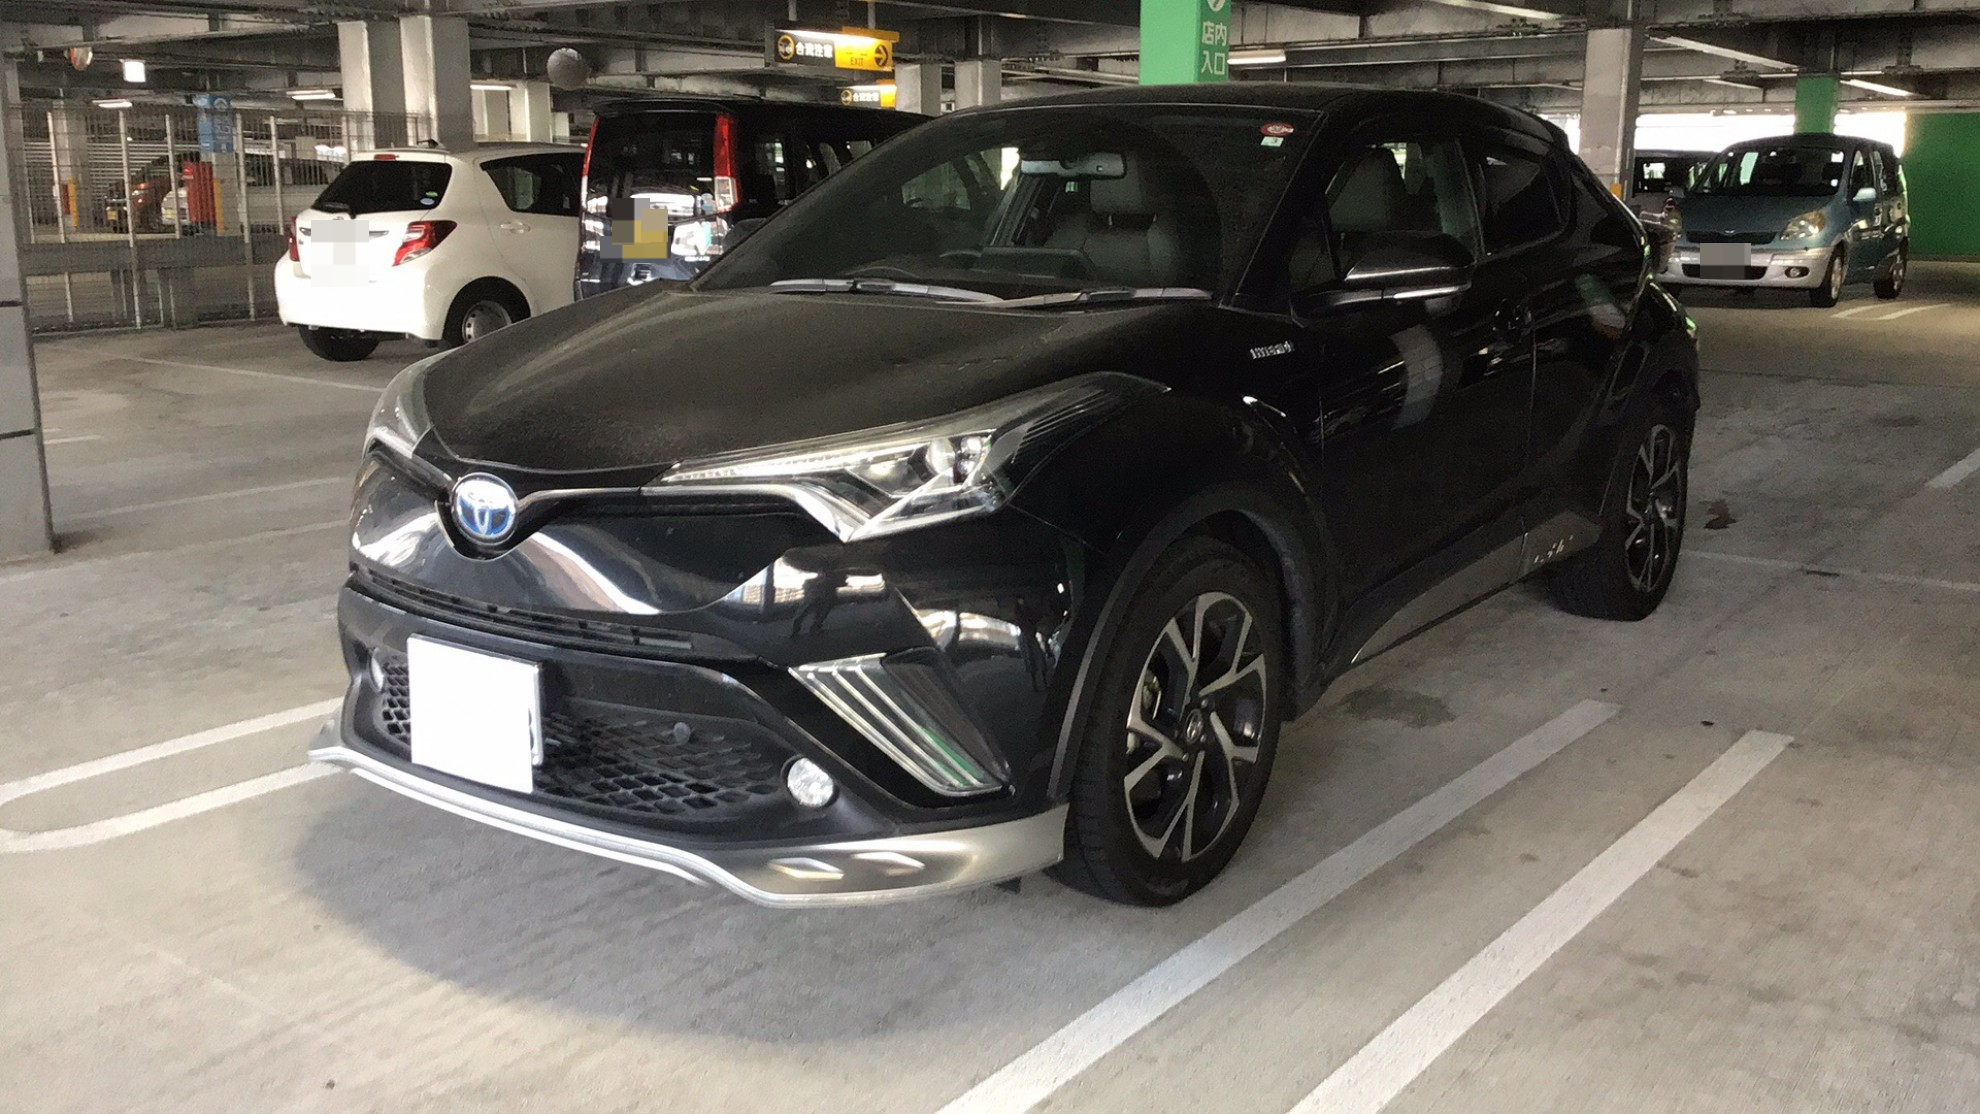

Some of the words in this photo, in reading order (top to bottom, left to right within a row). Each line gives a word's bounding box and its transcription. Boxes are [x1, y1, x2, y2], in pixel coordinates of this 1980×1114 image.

[1202, 21, 1227, 46] 店内
[850, 57, 864, 66] EXIT
[1201, 50, 1225, 75] 入口
